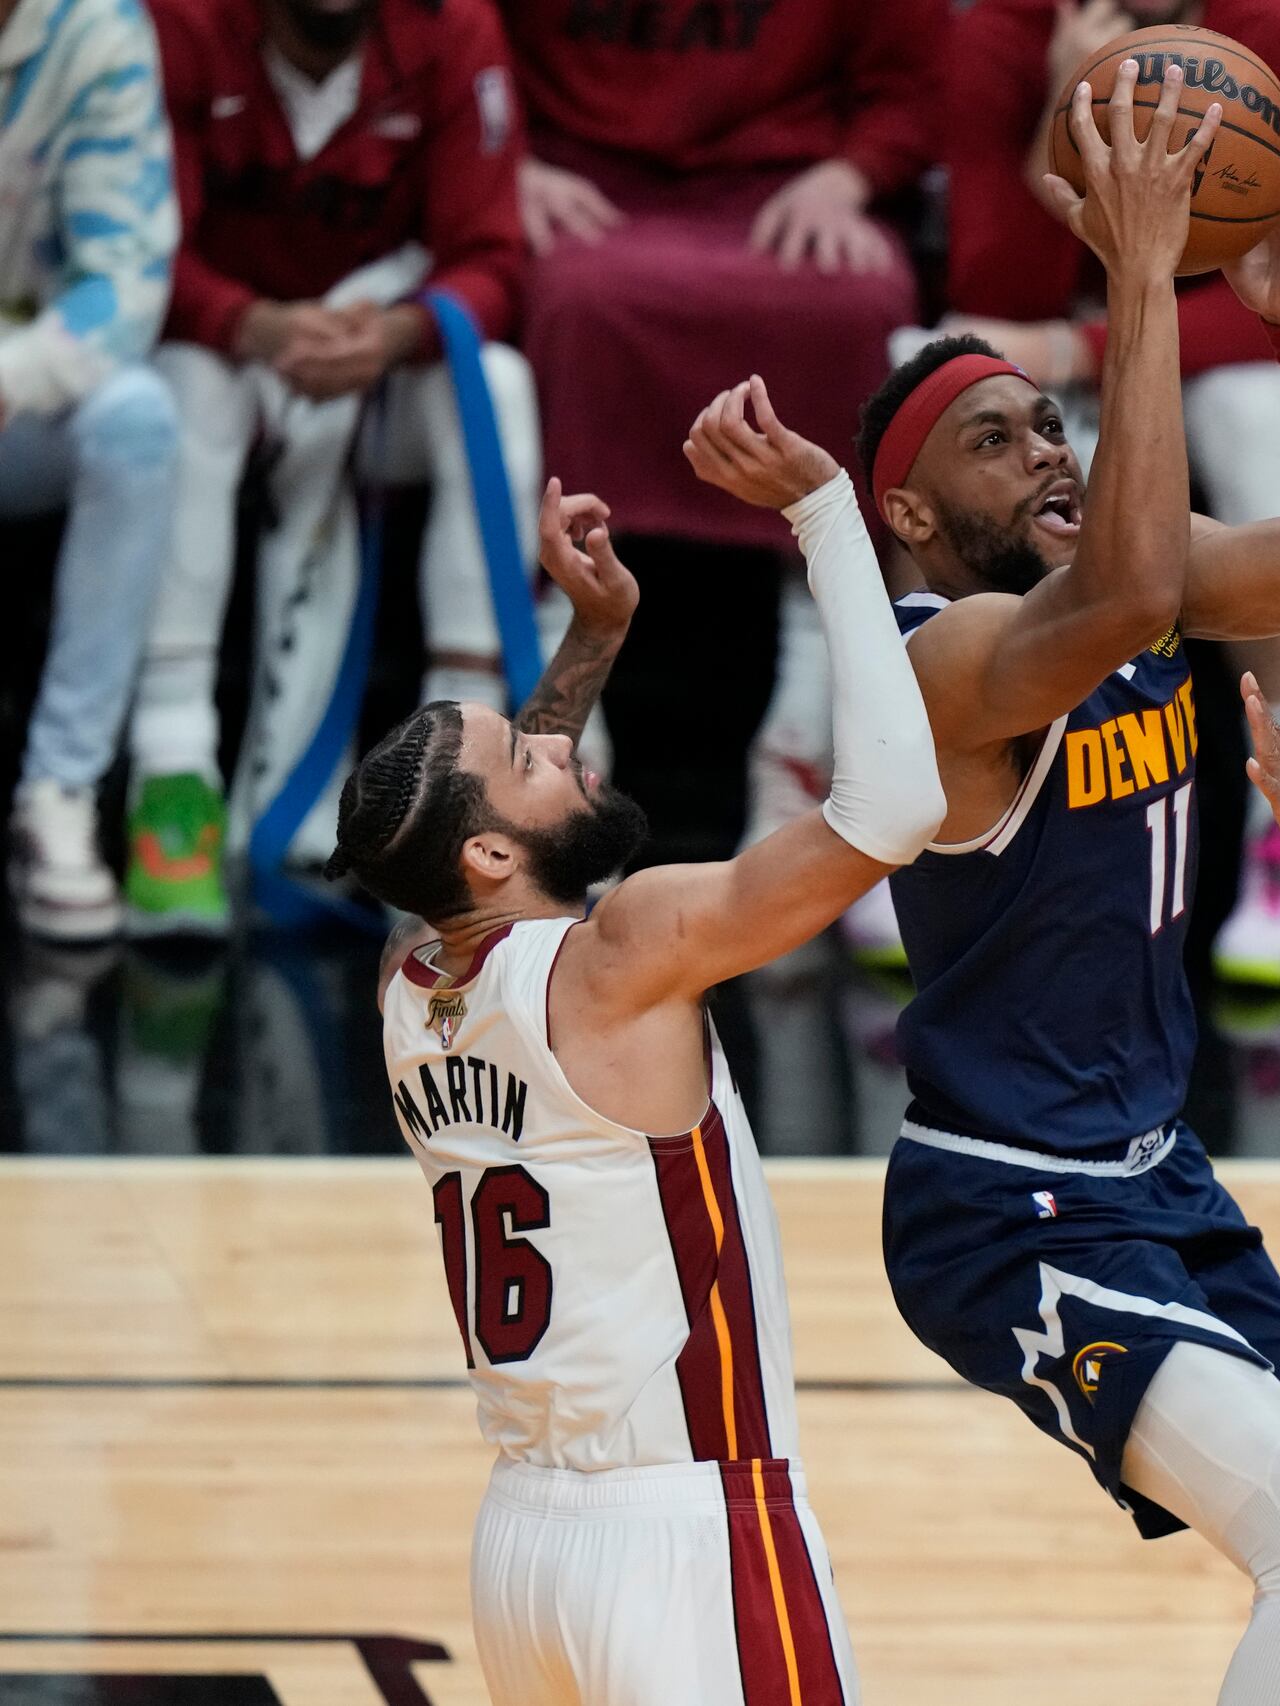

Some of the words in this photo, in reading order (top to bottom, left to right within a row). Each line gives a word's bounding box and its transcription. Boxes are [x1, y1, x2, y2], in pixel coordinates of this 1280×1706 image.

[1145, 780, 1193, 937] 11
[425, 996, 465, 1029] Finals
[394, 1055, 528, 1146] MARTIN
[432, 1163, 554, 1370] 16
